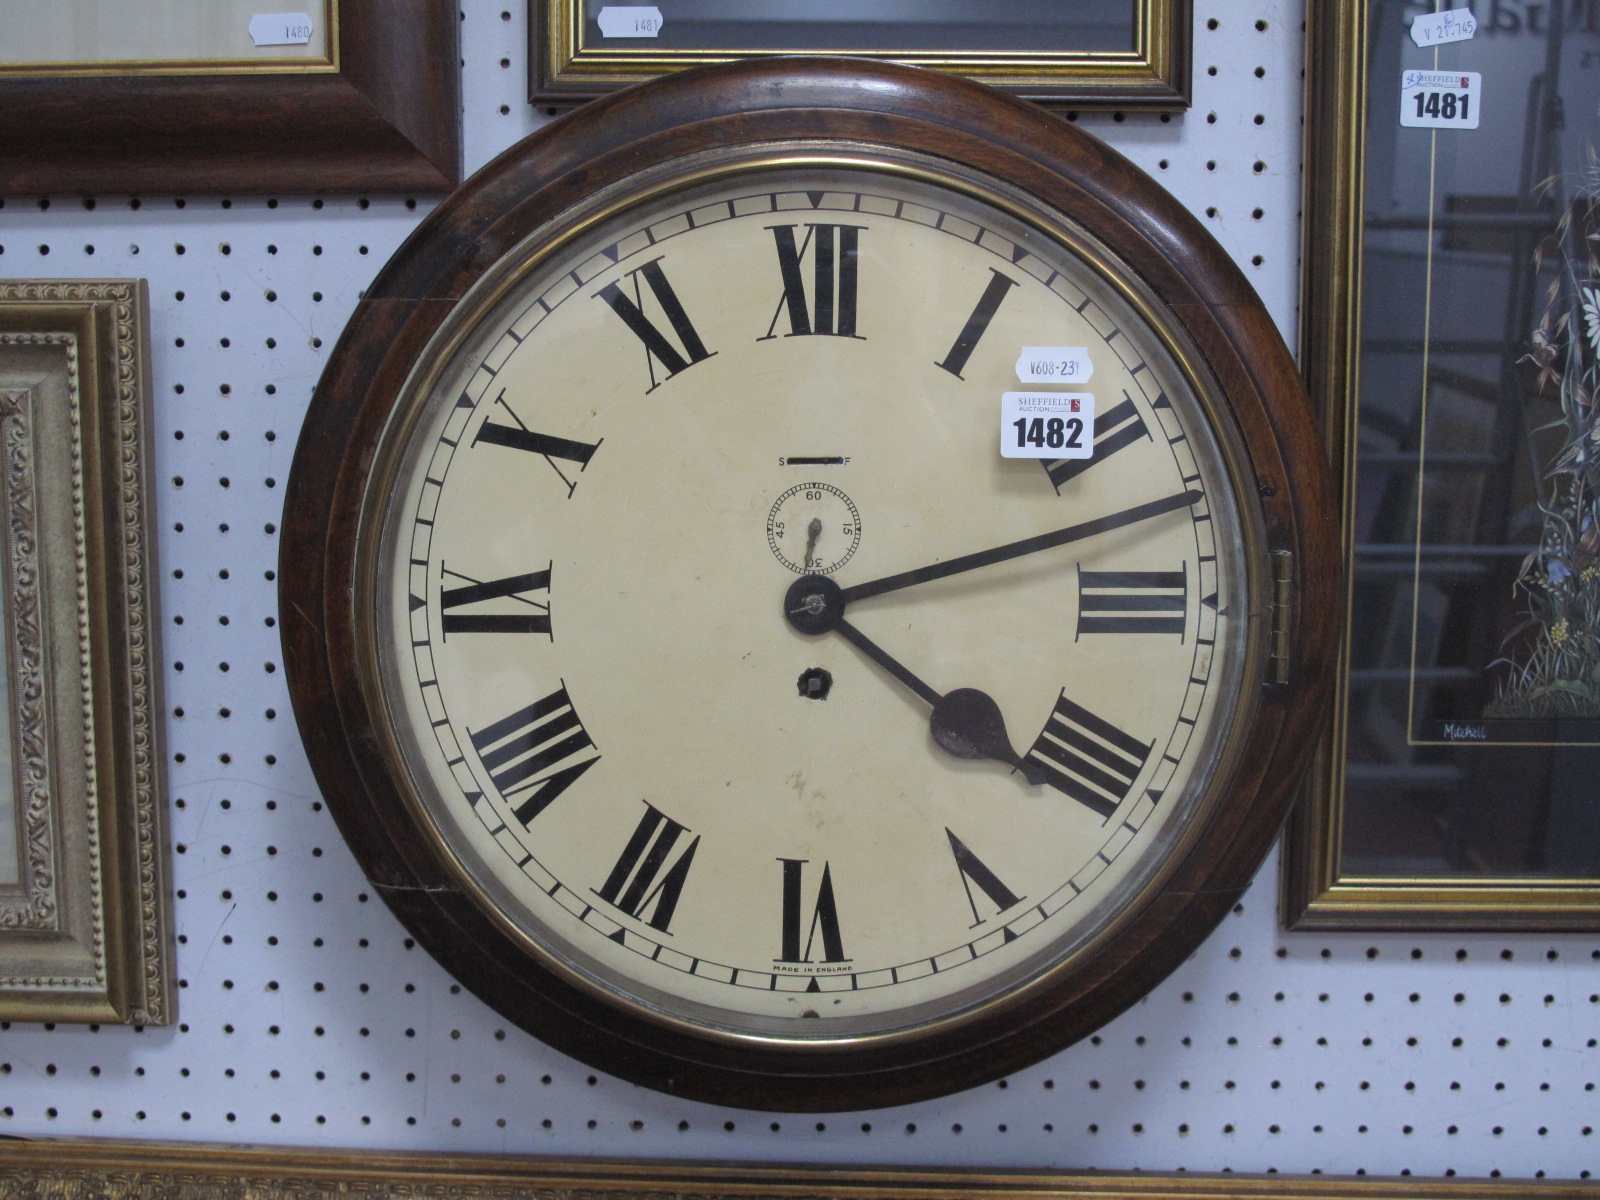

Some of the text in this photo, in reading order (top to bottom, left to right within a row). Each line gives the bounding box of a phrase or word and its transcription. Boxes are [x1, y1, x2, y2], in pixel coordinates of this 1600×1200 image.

[285, 25, 310, 39] 1480
[635, 19, 658, 31] 1481
[1413, 92, 1469, 119] 1481
[1416, 75, 1460, 83] SHEFFIELD
[756, 223, 869, 342] XII
[590, 255, 719, 395] XI
[934, 266, 1020, 381] I
[1018, 398, 1070, 406] SHEFFIELD
[471, 387, 604, 499] X
[1013, 417, 1084, 449] 1482
[806, 490, 822, 501] 60
[775, 521, 785, 539] 45
[843, 523, 853, 536] 15
[440, 559, 554, 643] IX
[1075, 560, 1187, 645] III
[466, 677, 603, 833] VIII
[589, 798, 702, 936] VII
[945, 826, 1028, 930] V
[773, 857, 854, 964] VI
[773, 965, 799, 973] MADE
[816, 965, 853, 973] ENGLAND
